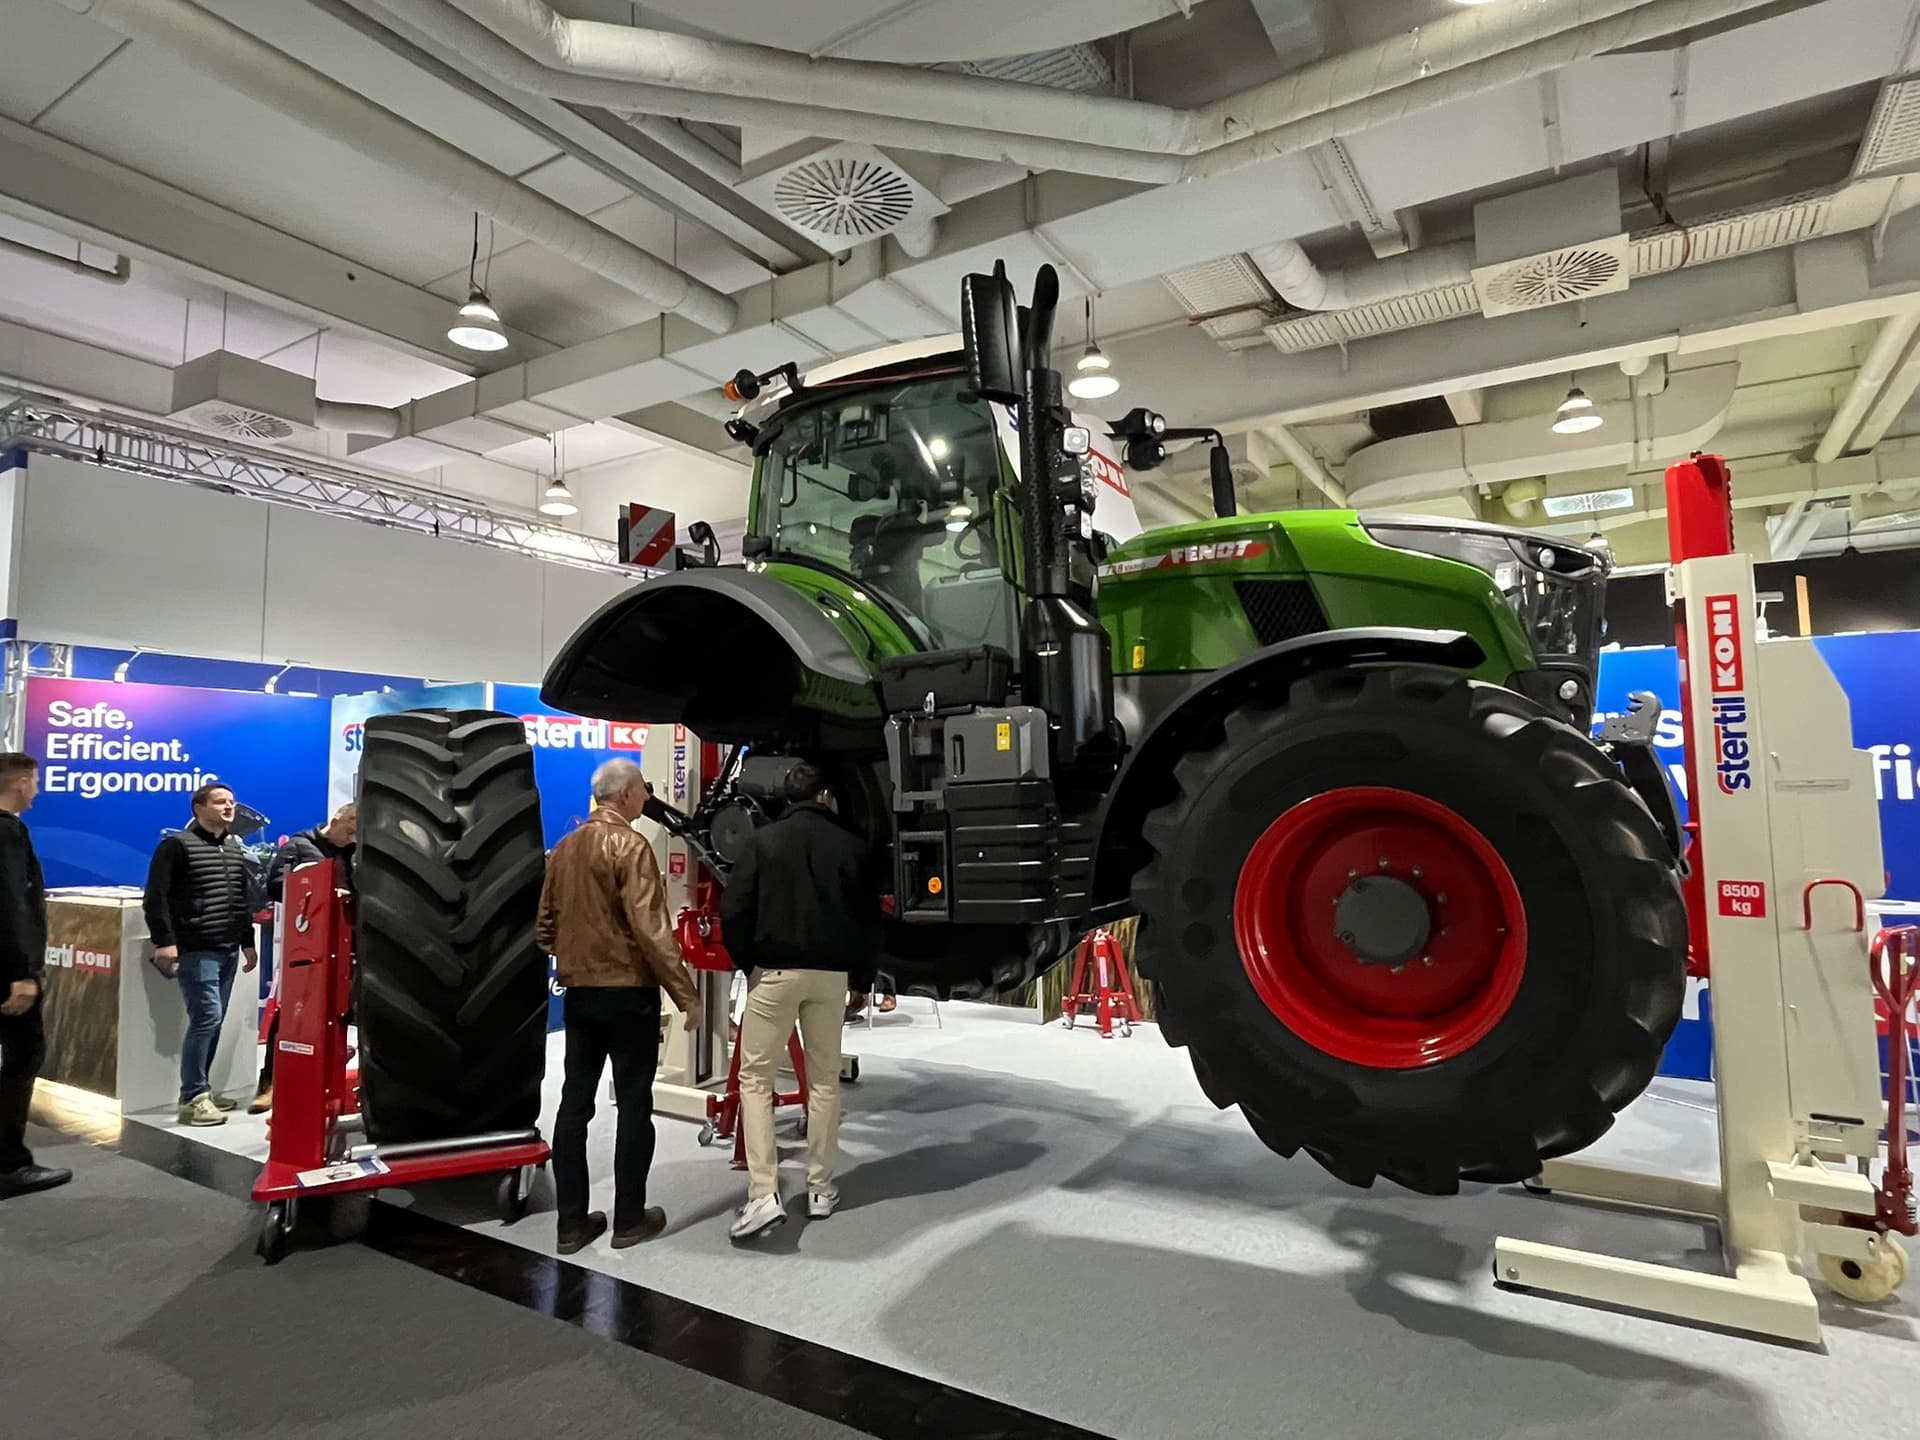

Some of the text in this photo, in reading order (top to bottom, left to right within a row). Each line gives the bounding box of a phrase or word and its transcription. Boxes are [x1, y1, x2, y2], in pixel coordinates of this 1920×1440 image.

[1090, 454, 1128, 492] ONI
[1170, 540, 1252, 564] FENDT
[1711, 600, 1751, 793] stertil KONI
[47, 700, 133, 730] Safe,
[525, 715, 606, 749] stertil
[613, 726, 648, 745] KO
[46, 733, 190, 762] Efficient,
[673, 745, 685, 802] stertil
[1722, 884, 1760, 899] 8500
[1732, 899, 1751, 915] kg
[45, 943, 74, 968] ertil
